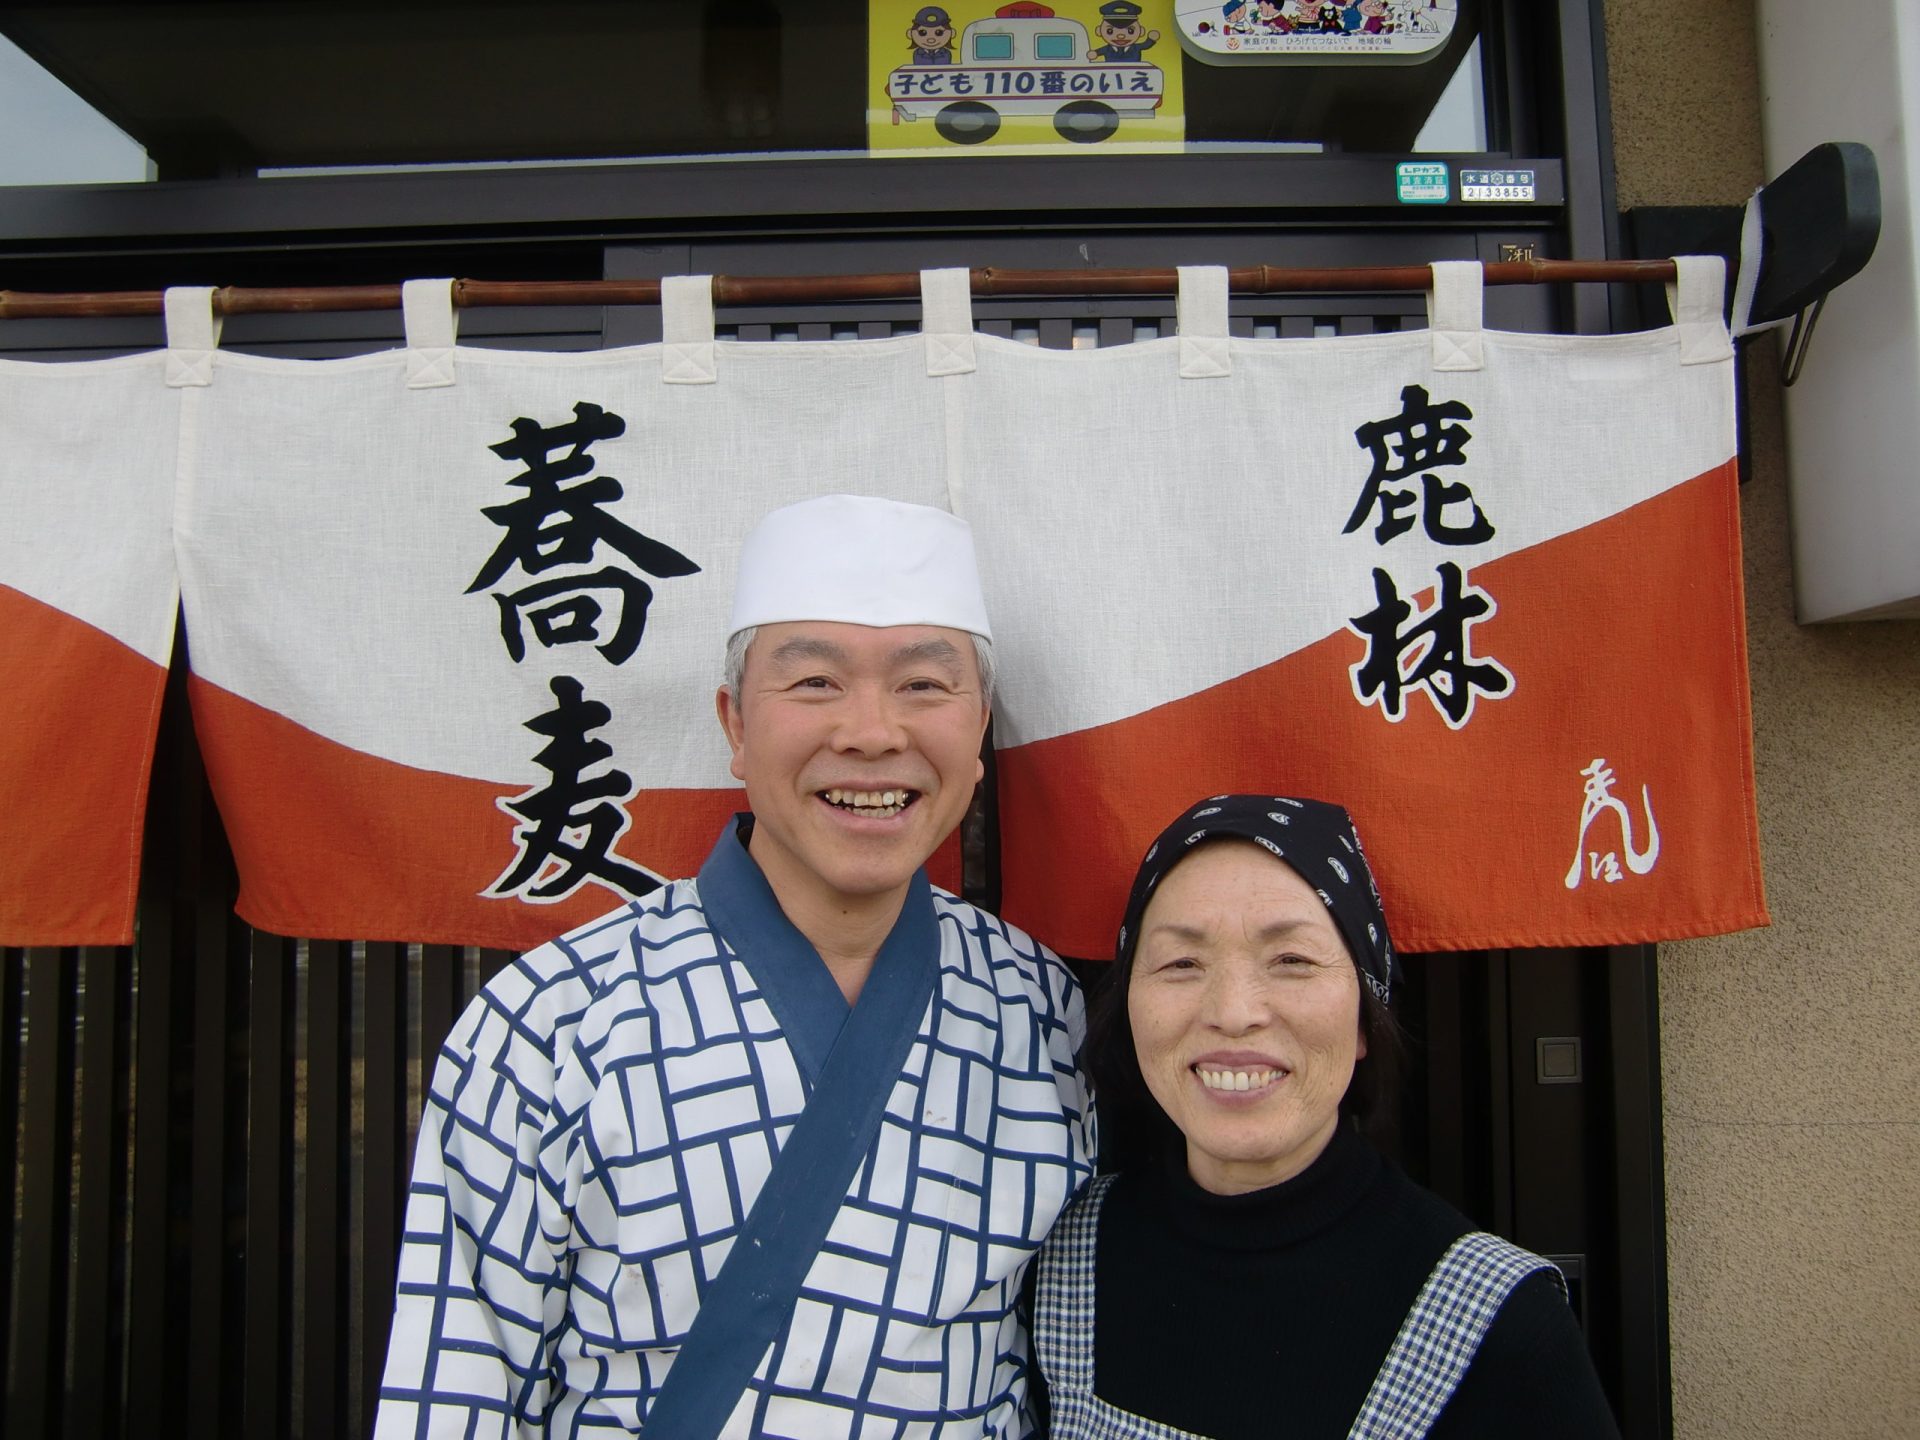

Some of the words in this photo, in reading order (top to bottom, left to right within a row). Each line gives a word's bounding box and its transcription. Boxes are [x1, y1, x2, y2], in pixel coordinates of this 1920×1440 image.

[894, 71, 1155, 95] 子ども110番のいえ
[1286, 38, 1350, 46] ひろげてつないで
[1341, 384, 1510, 724] 鹿林
[463, 401, 702, 898] 蕎麦
